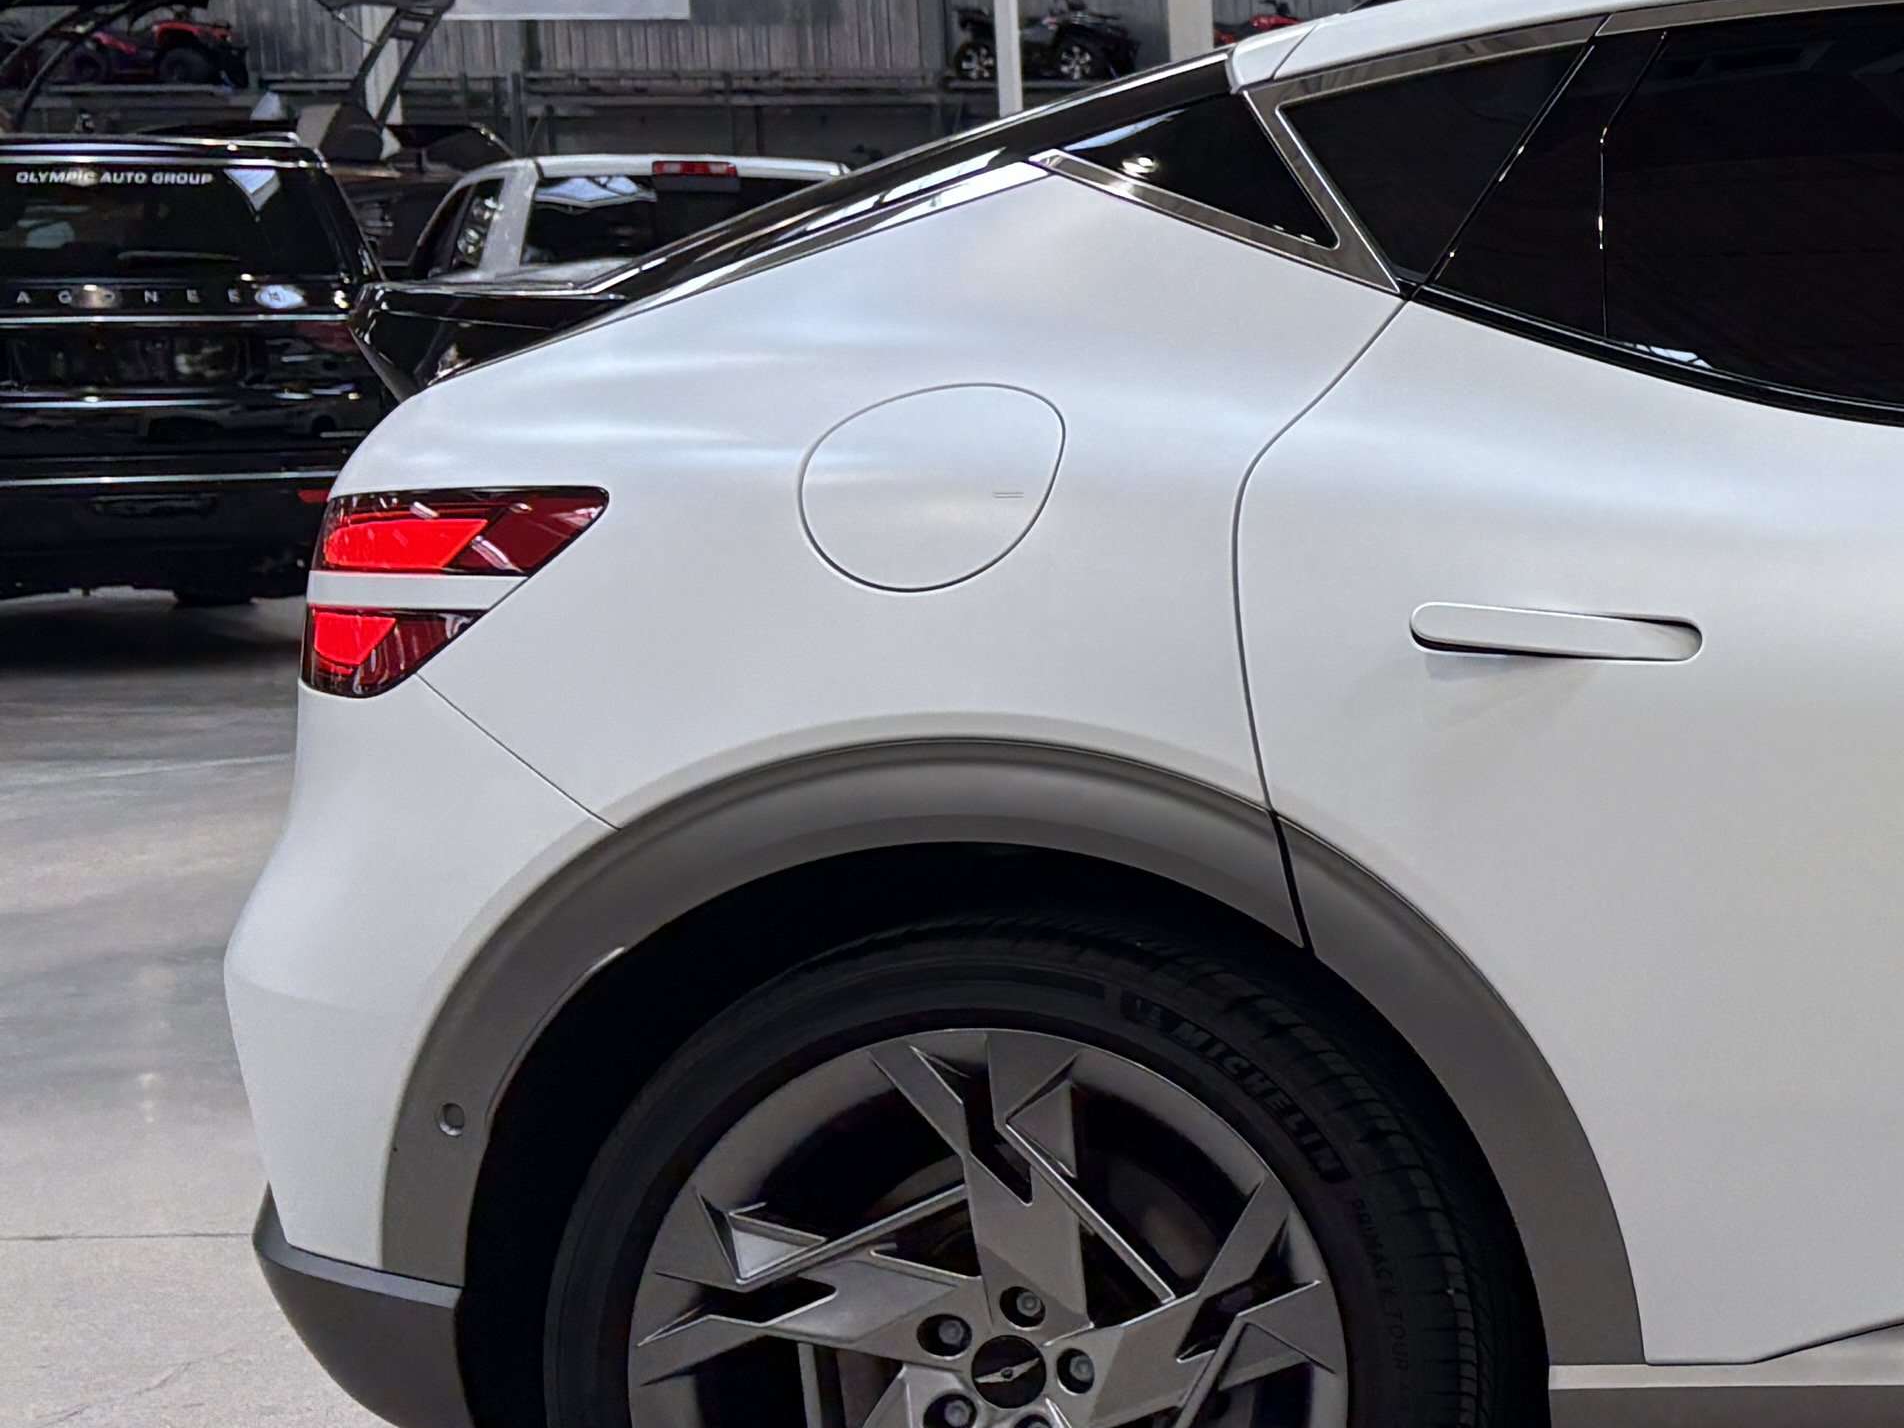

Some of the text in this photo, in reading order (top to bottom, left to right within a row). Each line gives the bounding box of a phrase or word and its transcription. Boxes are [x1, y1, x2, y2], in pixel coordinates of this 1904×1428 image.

[15, 170, 214, 185] OLYMPIC AUTO GROUP
[1170, 1017, 1345, 1177] MICHELIN
